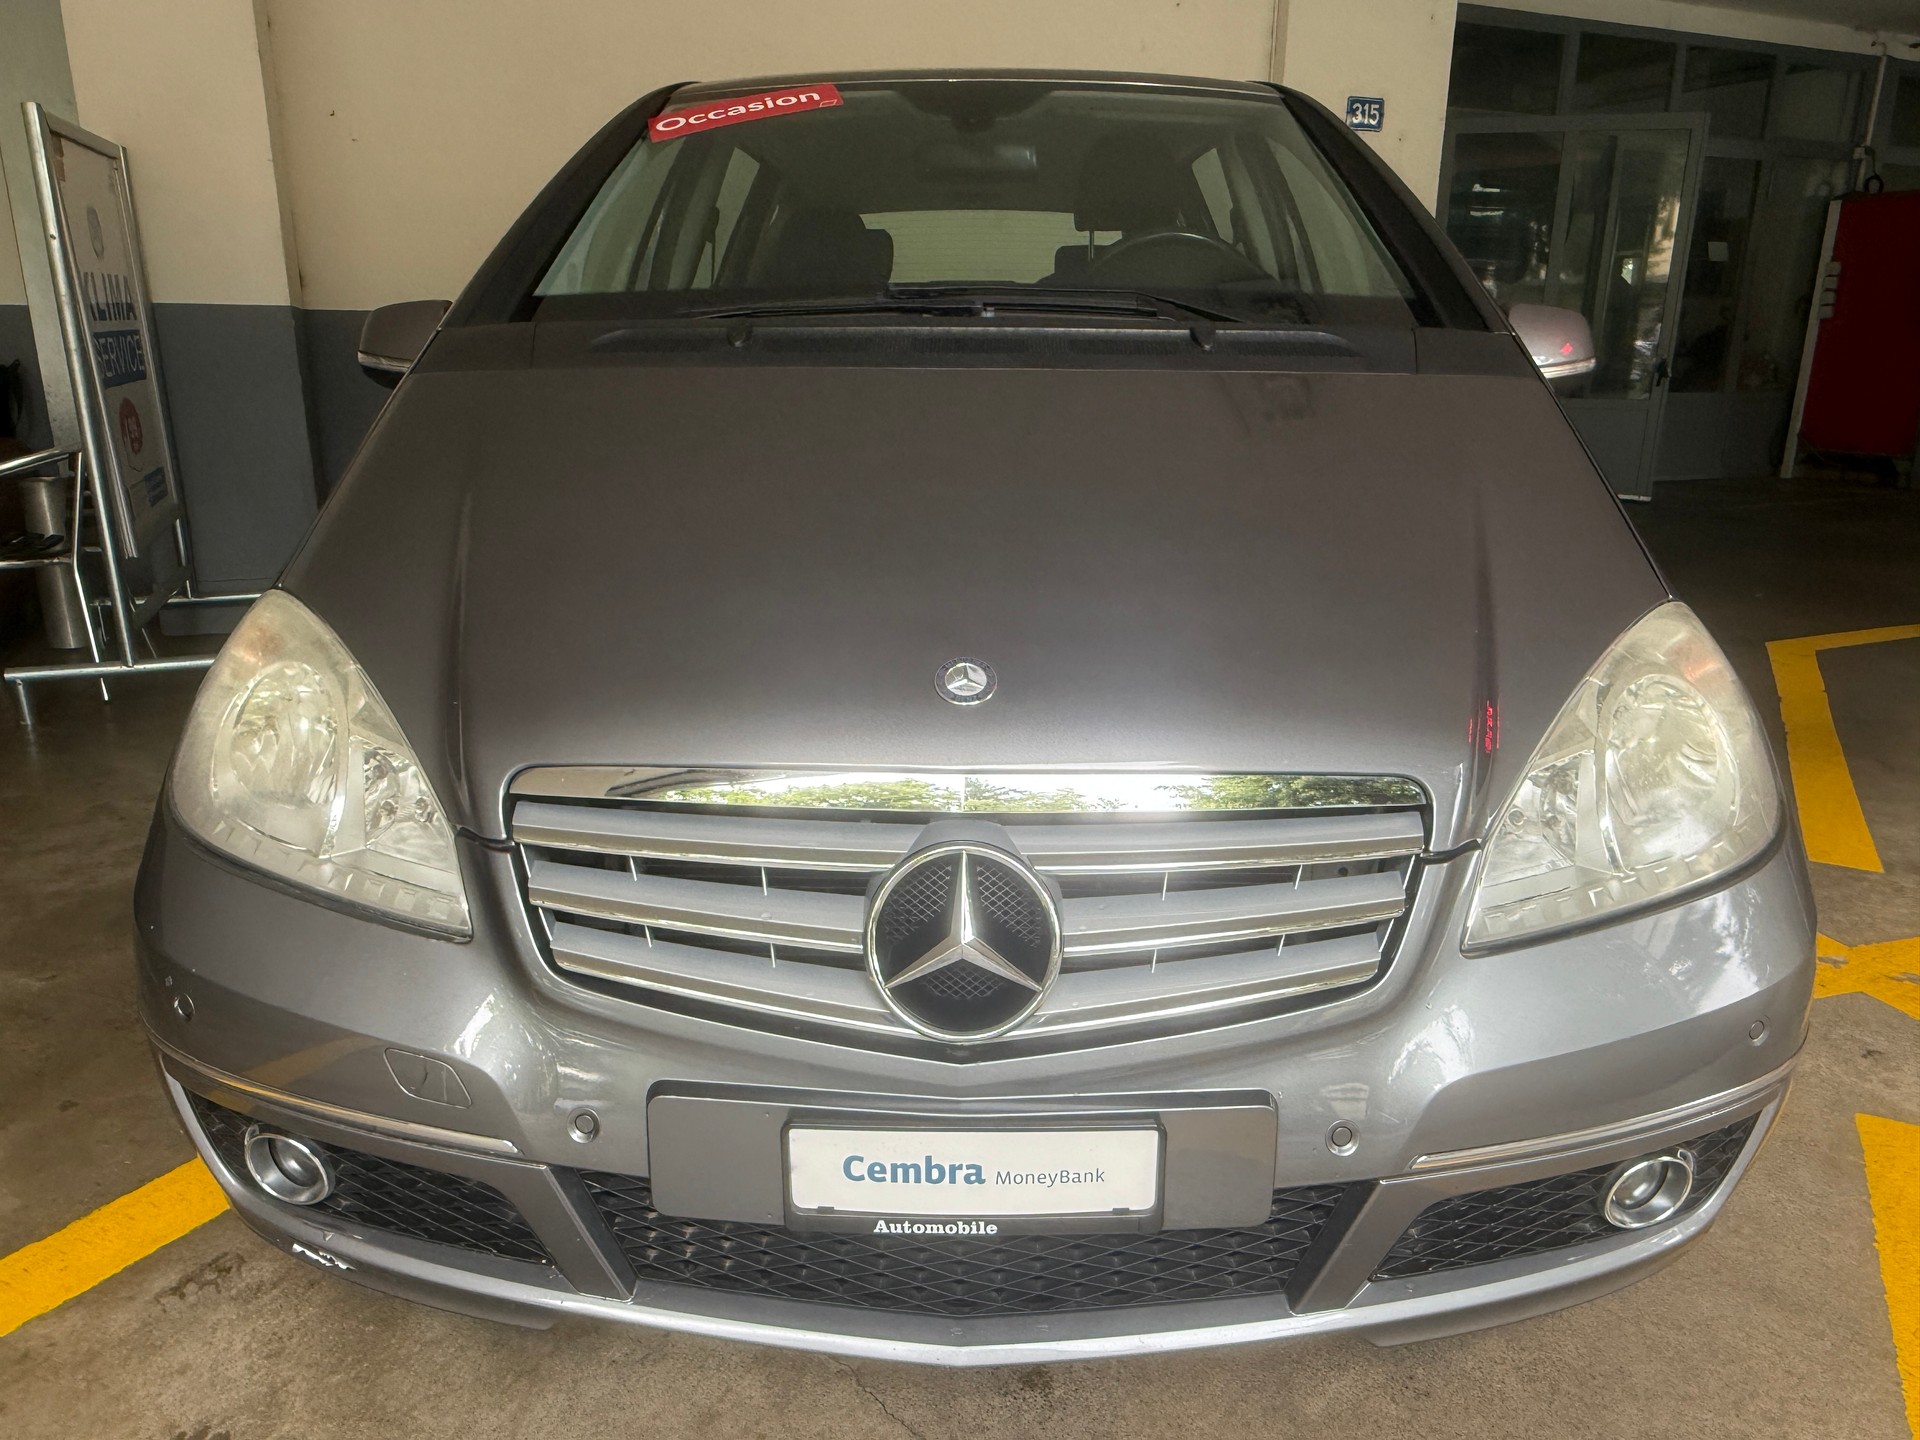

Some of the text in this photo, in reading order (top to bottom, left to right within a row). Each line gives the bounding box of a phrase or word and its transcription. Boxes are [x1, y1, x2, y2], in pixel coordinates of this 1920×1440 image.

[655, 92, 821, 131] Occasion
[1352, 103, 1380, 125] 315
[842, 1155, 1105, 1187] Cembra MoneyBank
[873, 1220, 998, 1235] Automobile
